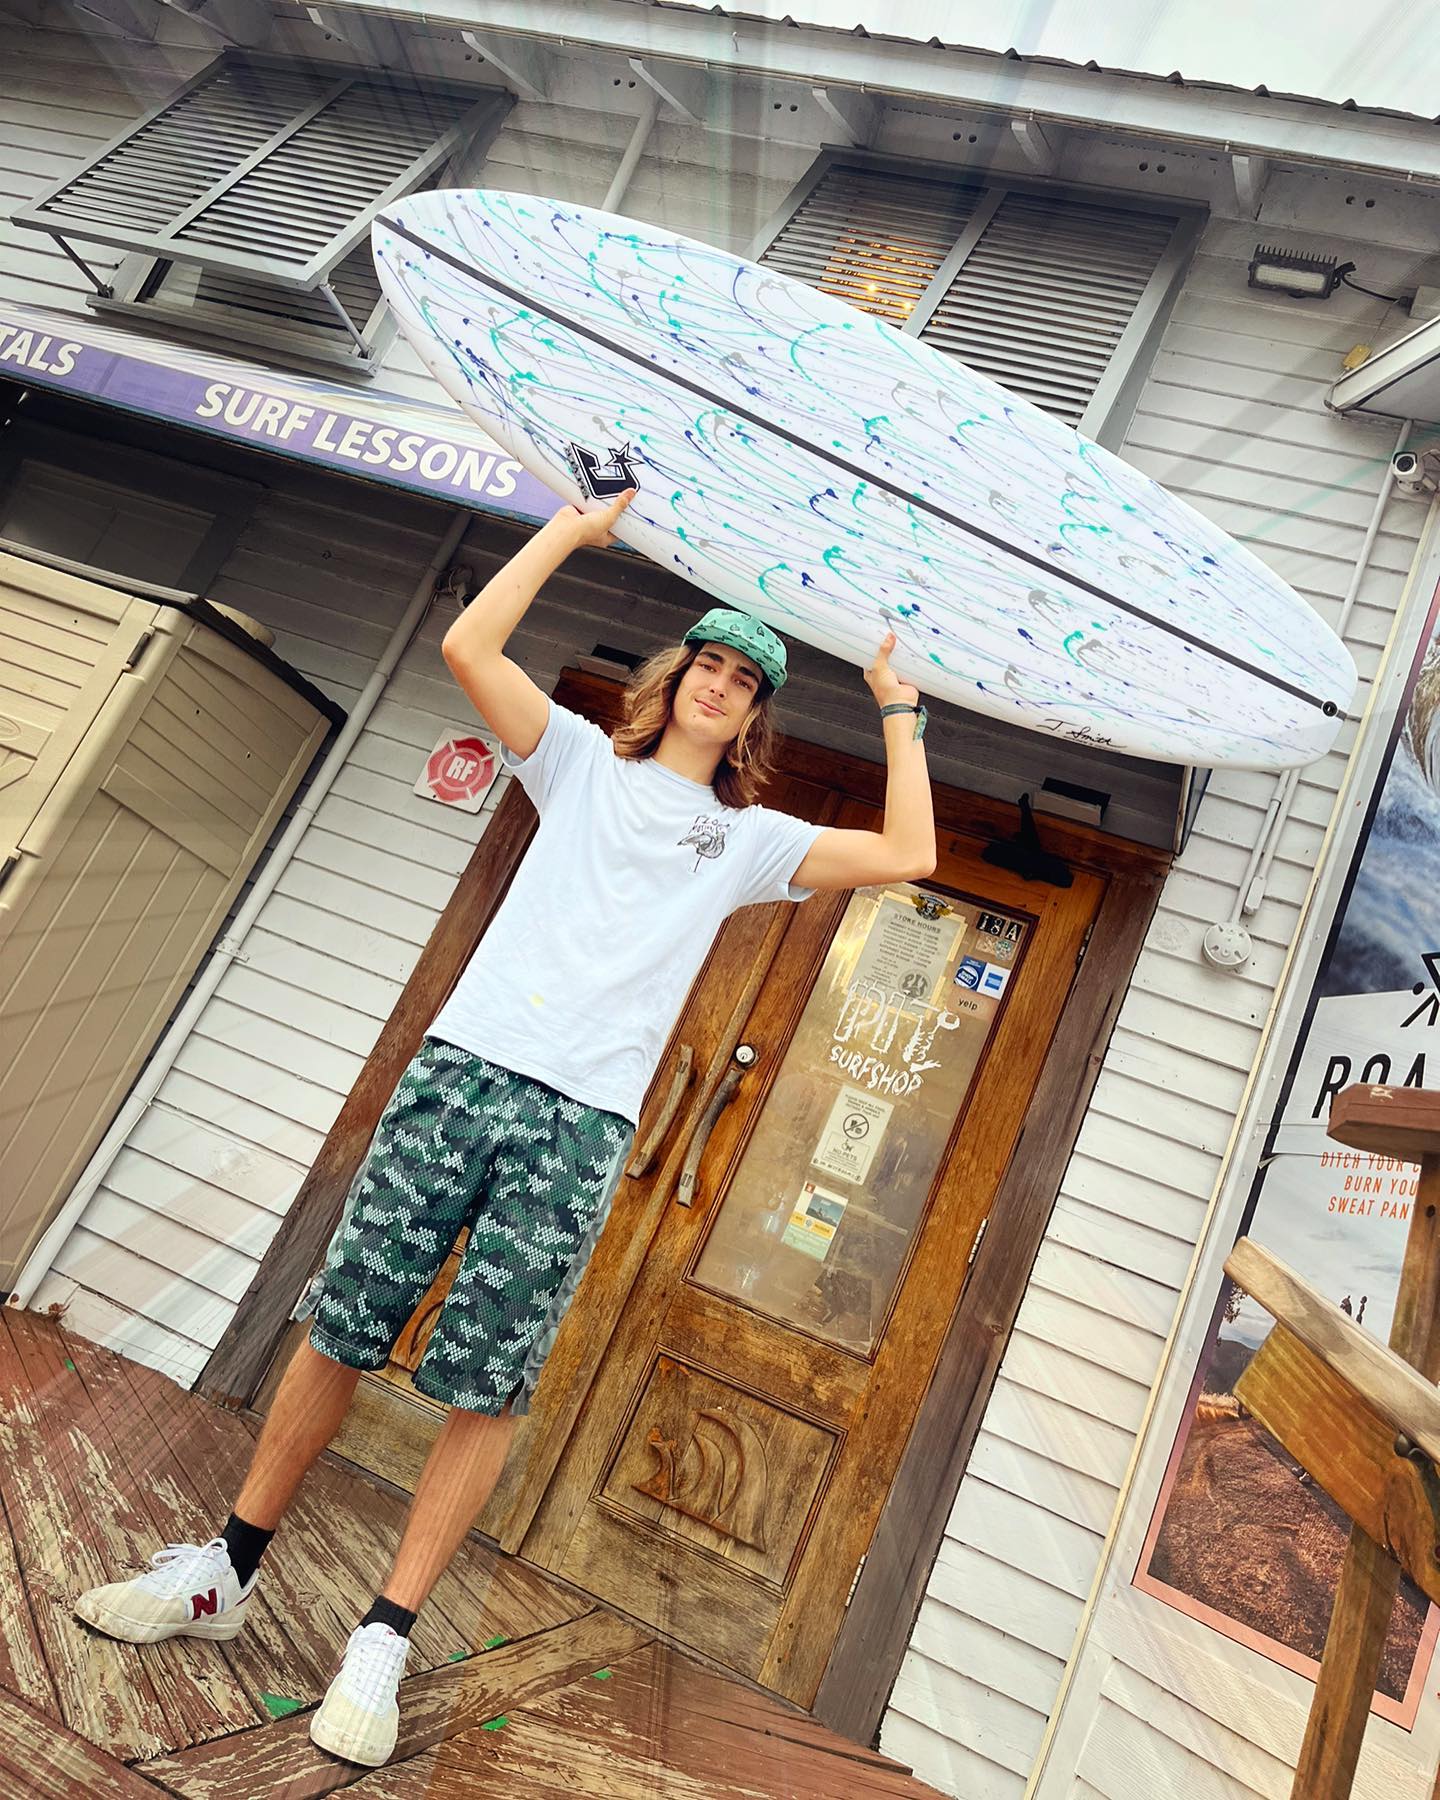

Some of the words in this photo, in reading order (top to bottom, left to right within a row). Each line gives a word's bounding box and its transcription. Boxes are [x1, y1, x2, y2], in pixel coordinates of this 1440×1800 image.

[195, 383, 314, 440] SURF
[312, 415, 524, 497] LESSONS
[446, 756, 477, 782] RF
[958, 998, 978, 1010] yelp
[1321, 1152, 1361, 1169] DITCH
[1344, 1175, 1382, 1193] BURN
[1328, 1196, 1375, 1216] SWEAT
[1380, 1202, 1416, 1220] PAN
[192, 1588, 218, 1621] N
